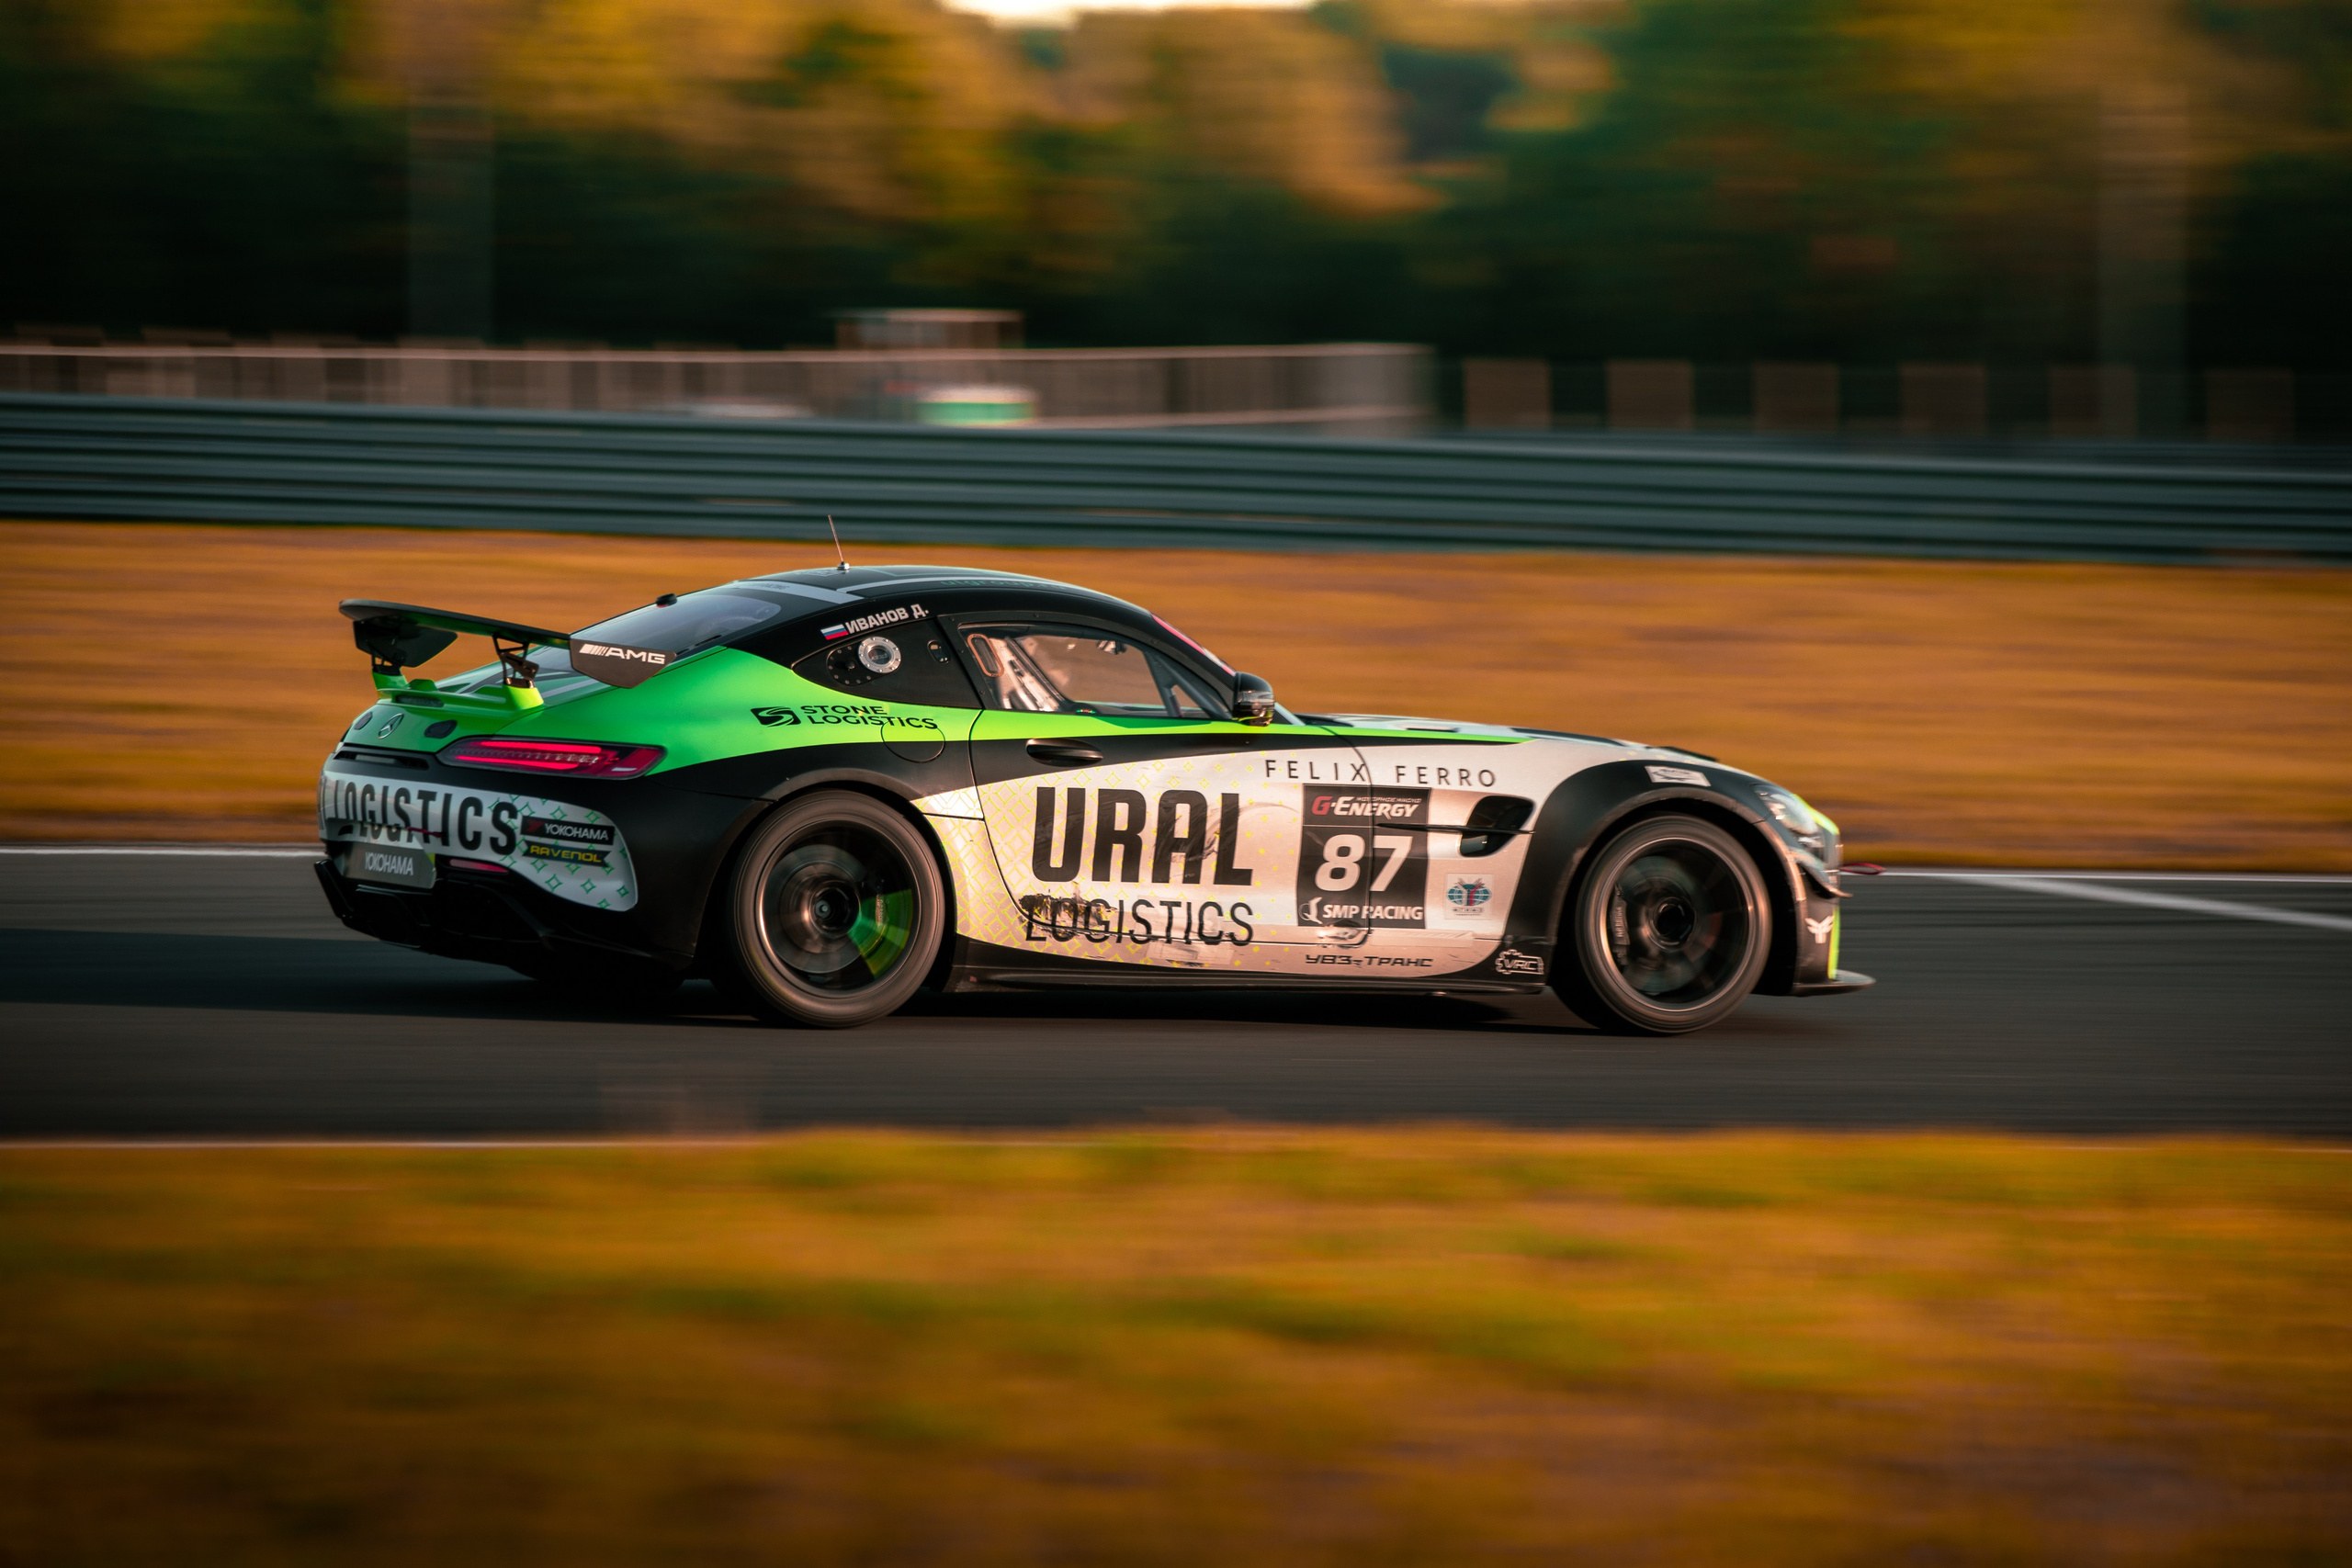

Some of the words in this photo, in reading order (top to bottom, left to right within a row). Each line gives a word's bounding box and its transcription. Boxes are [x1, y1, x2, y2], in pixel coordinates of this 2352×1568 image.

[845, 607, 910, 635] ИВАНОВ
[910, 604, 930, 619] Д.
[606, 647, 666, 665] AMG
[803, 705, 888, 716] STONE
[808, 716, 938, 729] LOGISTICS
[1264, 759, 1367, 782] FELIX
[1395, 765, 1497, 787] FERRO
[545, 823, 609, 841] YOKOHAMA
[1032, 786, 1253, 886] URAL
[530, 845, 603, 863] RAVENOL
[1314, 834, 1414, 892] 87
[365, 852, 414, 876] YOKOHAMA
[1024, 897, 1254, 946] LOGISTICS
[1322, 905, 1361, 919] SMP
[1361, 905, 1424, 920] RACING
[1503, 958, 1539, 970] VRC
